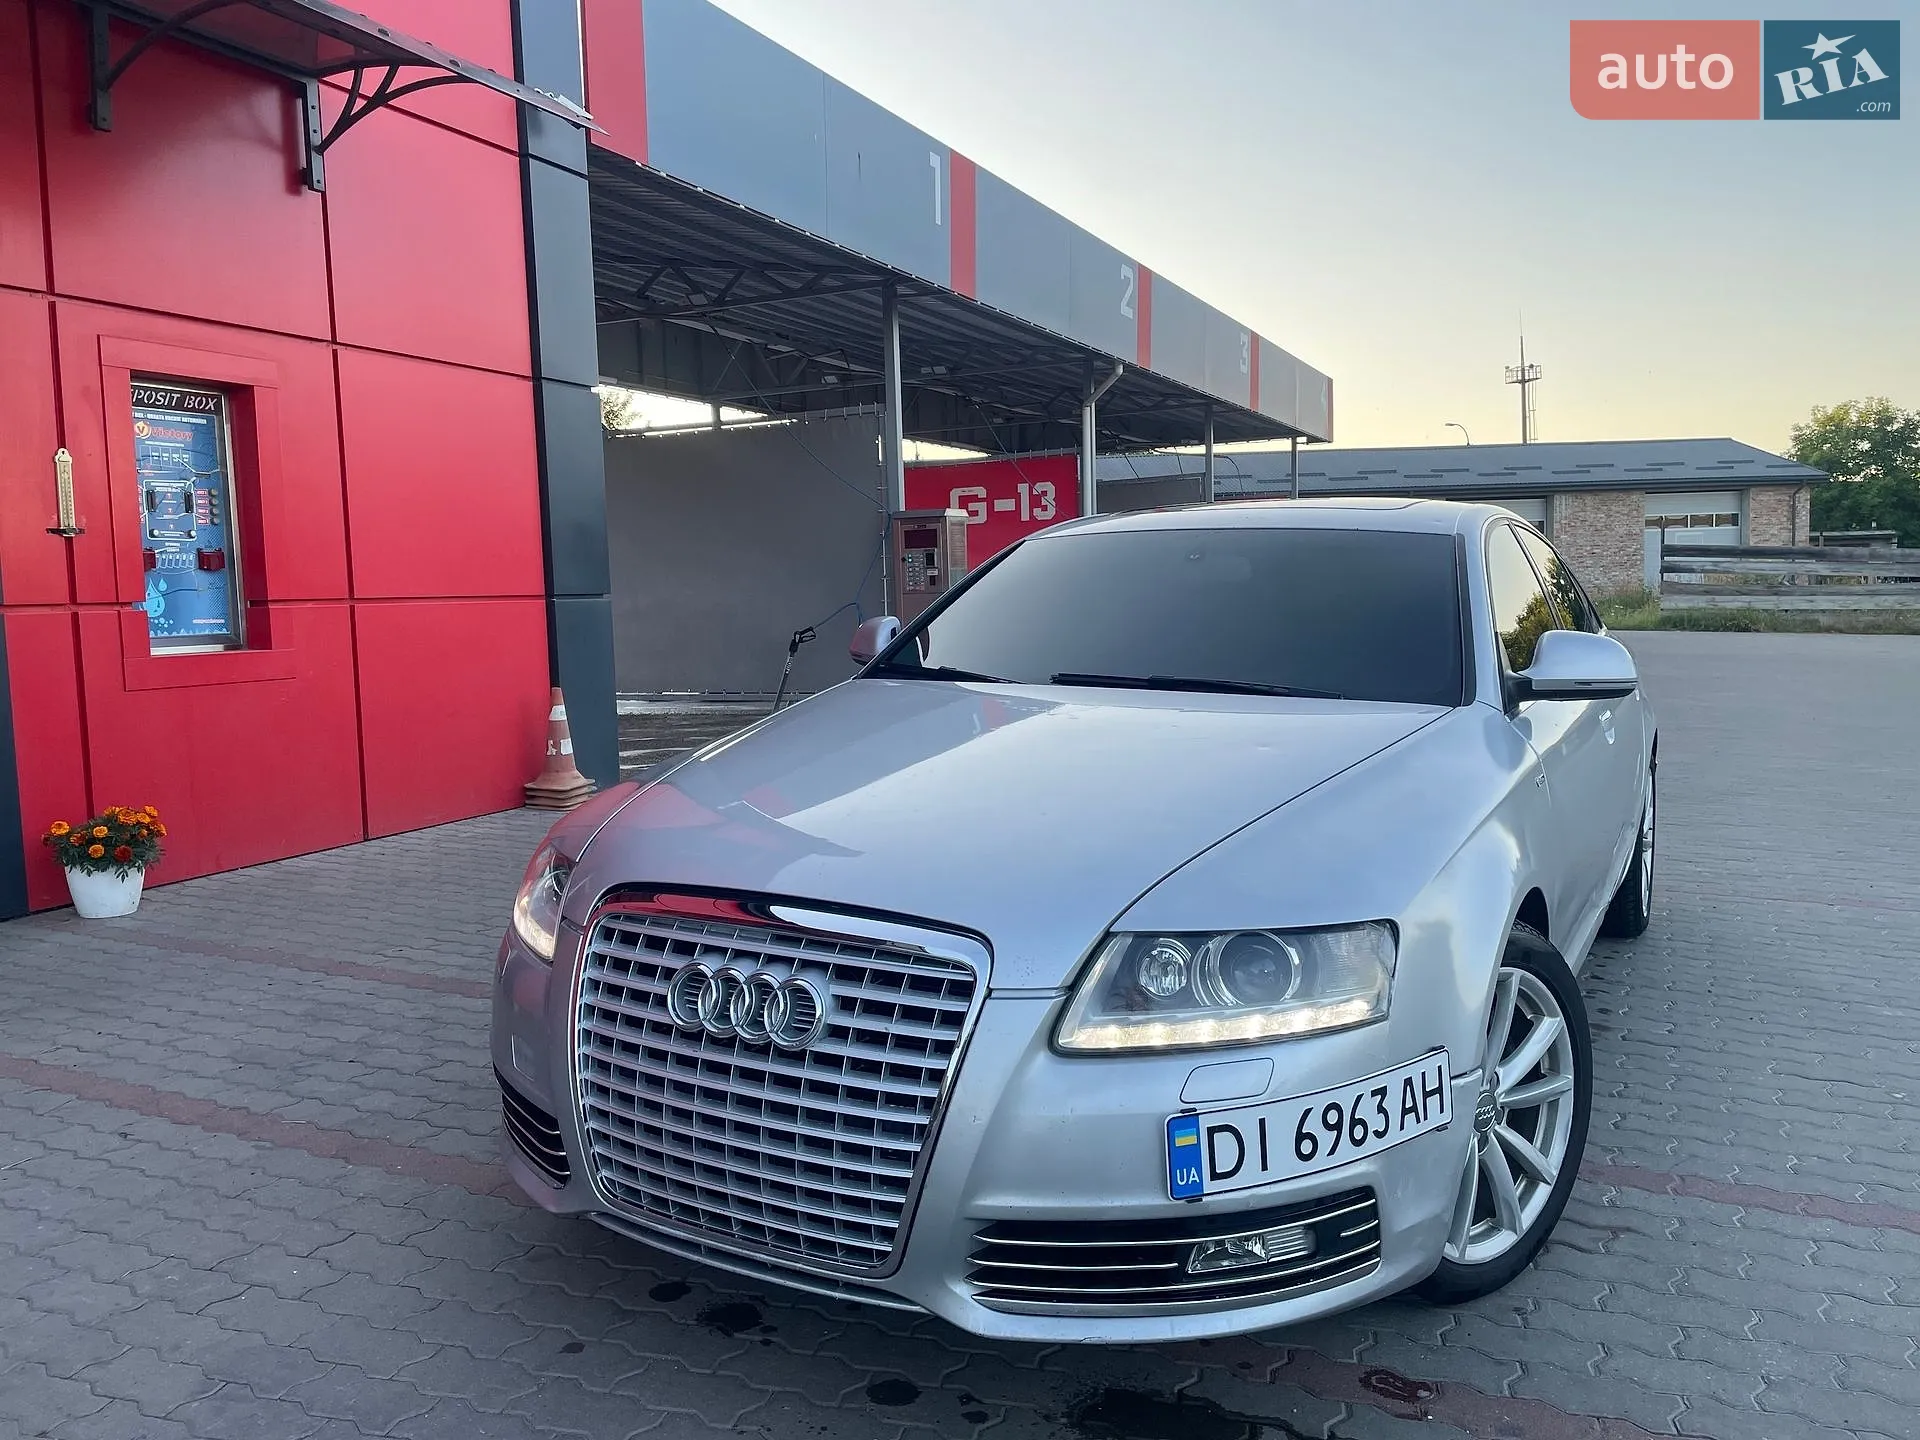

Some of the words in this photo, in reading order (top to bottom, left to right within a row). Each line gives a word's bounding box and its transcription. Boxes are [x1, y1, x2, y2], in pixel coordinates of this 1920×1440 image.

[929, 151, 942, 226] 1
[1120, 263, 1134, 320] 2
[1240, 331, 1249, 376] 3
[131, 388, 180, 407] POSIT
[184, 395, 217, 411] BOX
[950, 481, 1056, 525] G-13
[1206, 1117, 1268, 1182] DI
[1295, 1085, 1390, 1162] 6963
[1400, 1064, 1445, 1132] AH
[1176, 1166, 1200, 1186] UA
